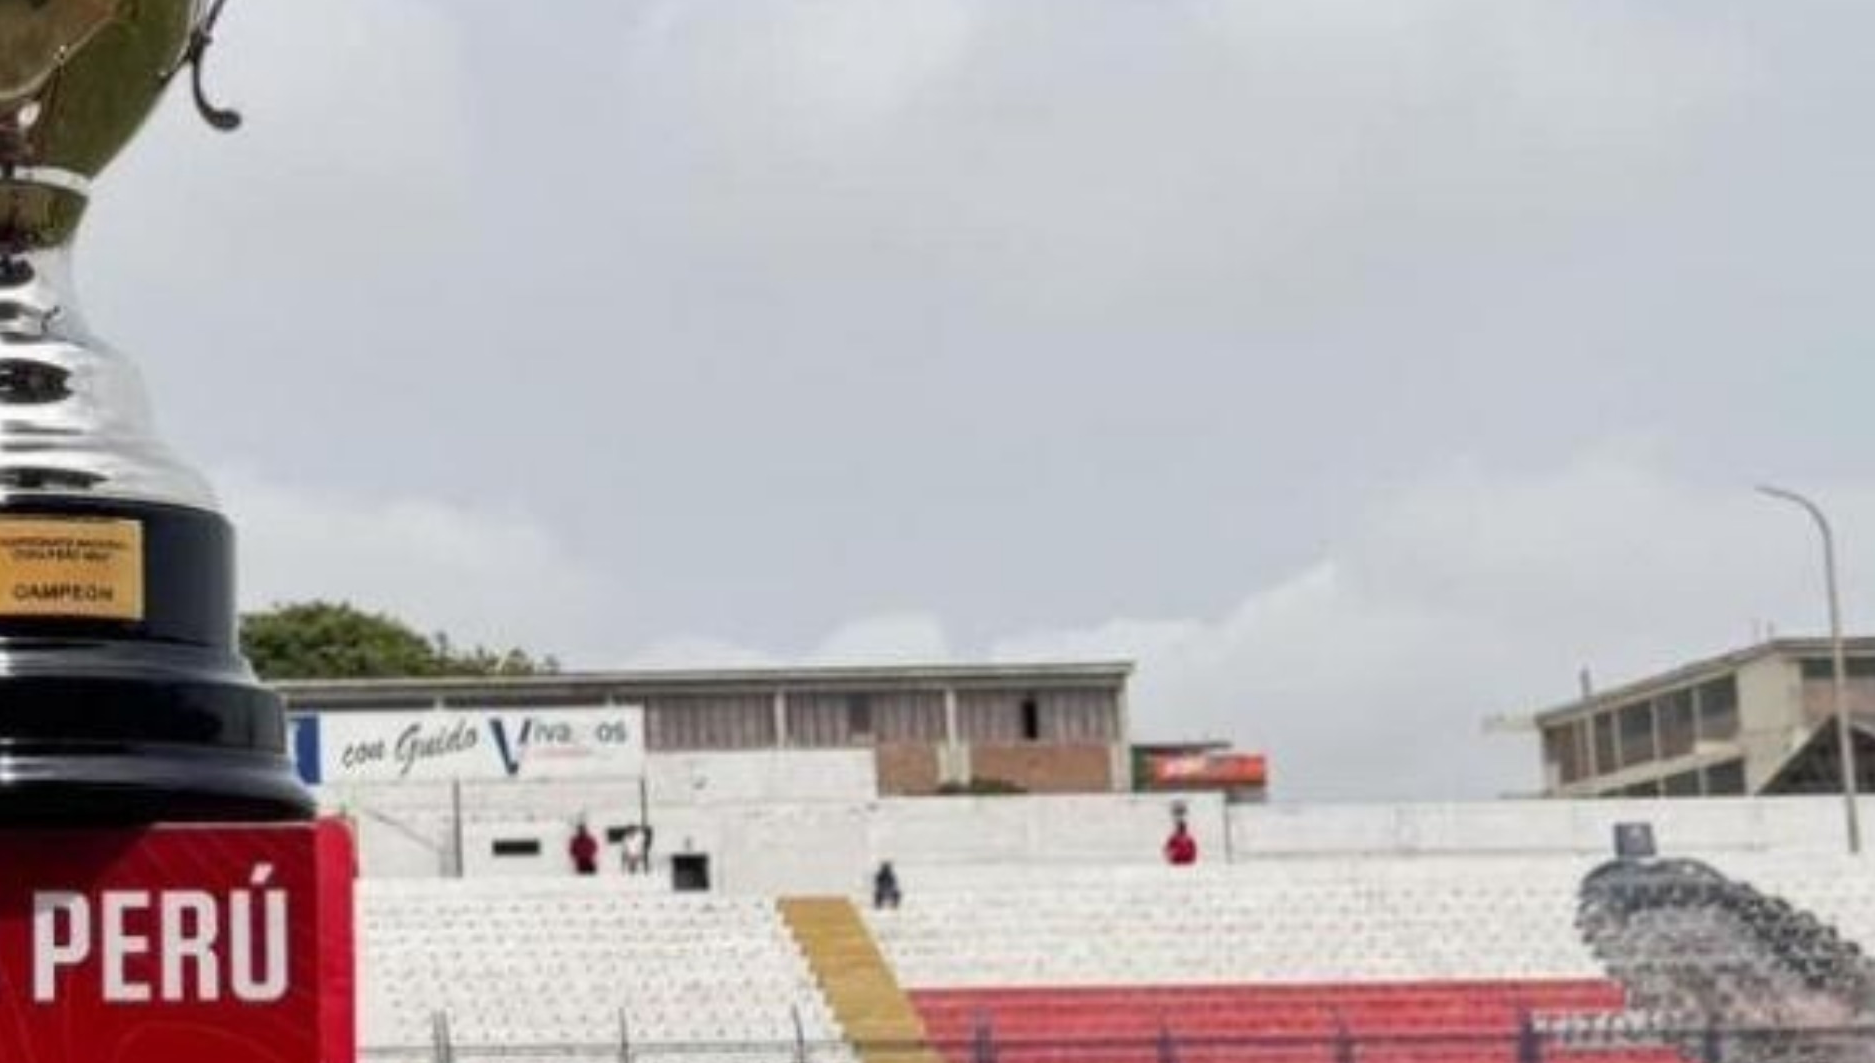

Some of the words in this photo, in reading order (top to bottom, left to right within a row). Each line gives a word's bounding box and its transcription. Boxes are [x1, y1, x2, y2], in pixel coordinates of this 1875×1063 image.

[342, 739, 385, 768] con
[395, 721, 477, 774] Guido
[32, 863, 289, 1002] PERÚ
